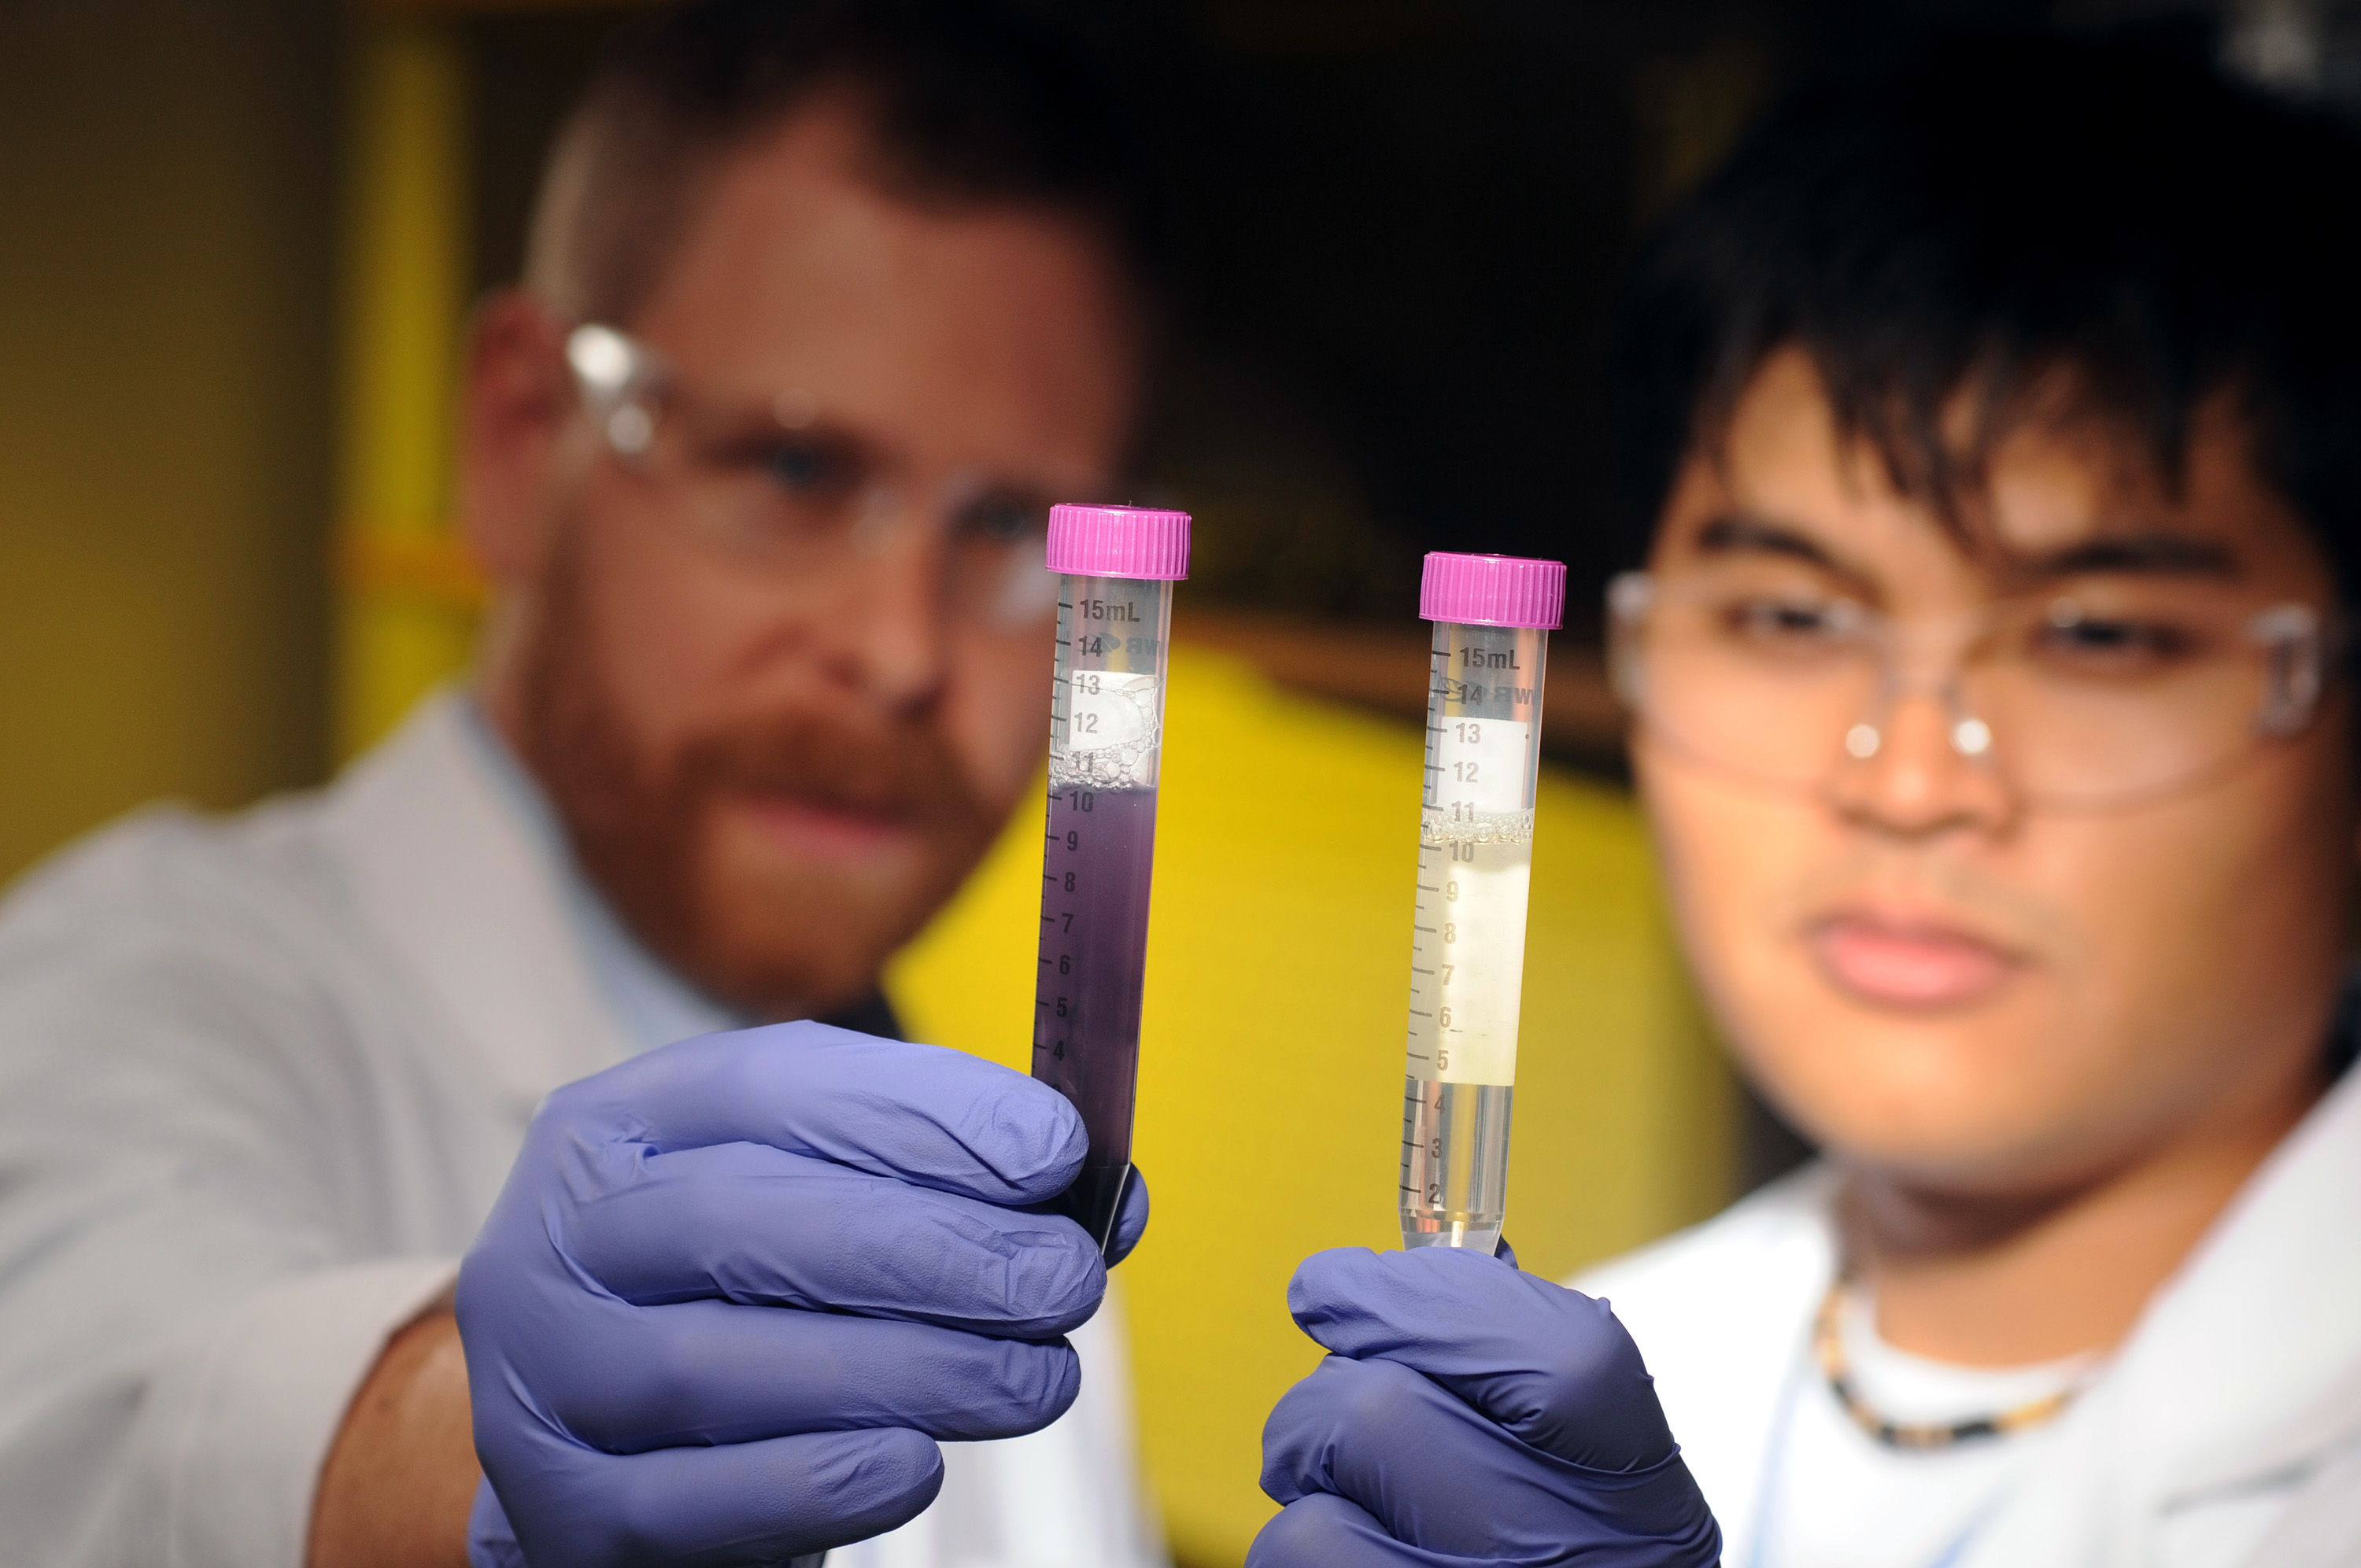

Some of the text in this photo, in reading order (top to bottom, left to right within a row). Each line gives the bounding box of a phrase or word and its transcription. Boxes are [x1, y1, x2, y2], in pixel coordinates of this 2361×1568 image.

[1080, 599, 1140, 622] 15mL
[1078, 636, 1103, 657] 14
[1460, 647, 1520, 670] 15mL
[1076, 674, 1101, 695] 13
[1458, 684, 1483, 705] 14
[1073, 712, 1099, 733] 12
[1456, 722, 1480, 743] 13
[1072, 751, 1094, 773] 11
[1454, 762, 1479, 783] 12
[1070, 791, 1094, 812] 10
[1451, 801, 1475, 822] 11
[1067, 831, 1078, 851] 9
[1449, 841, 1474, 862] 10
[1064, 872, 1076, 892] 8
[1447, 881, 1458, 902] 9
[1062, 913, 1073, 933] 7
[1444, 922, 1456, 944] 8
[1059, 954, 1070, 975] 6
[1442, 964, 1454, 985] 7
[1056, 997, 1067, 1018] 5
[1439, 1006, 1452, 1028] 6
[1053, 1041, 1064, 1061] 4
[1436, 1050, 1449, 1071] 5
[1434, 1094, 1446, 1114] 4
[1431, 1138, 1443, 1159] 3
[1428, 1183, 1440, 1204] 2
